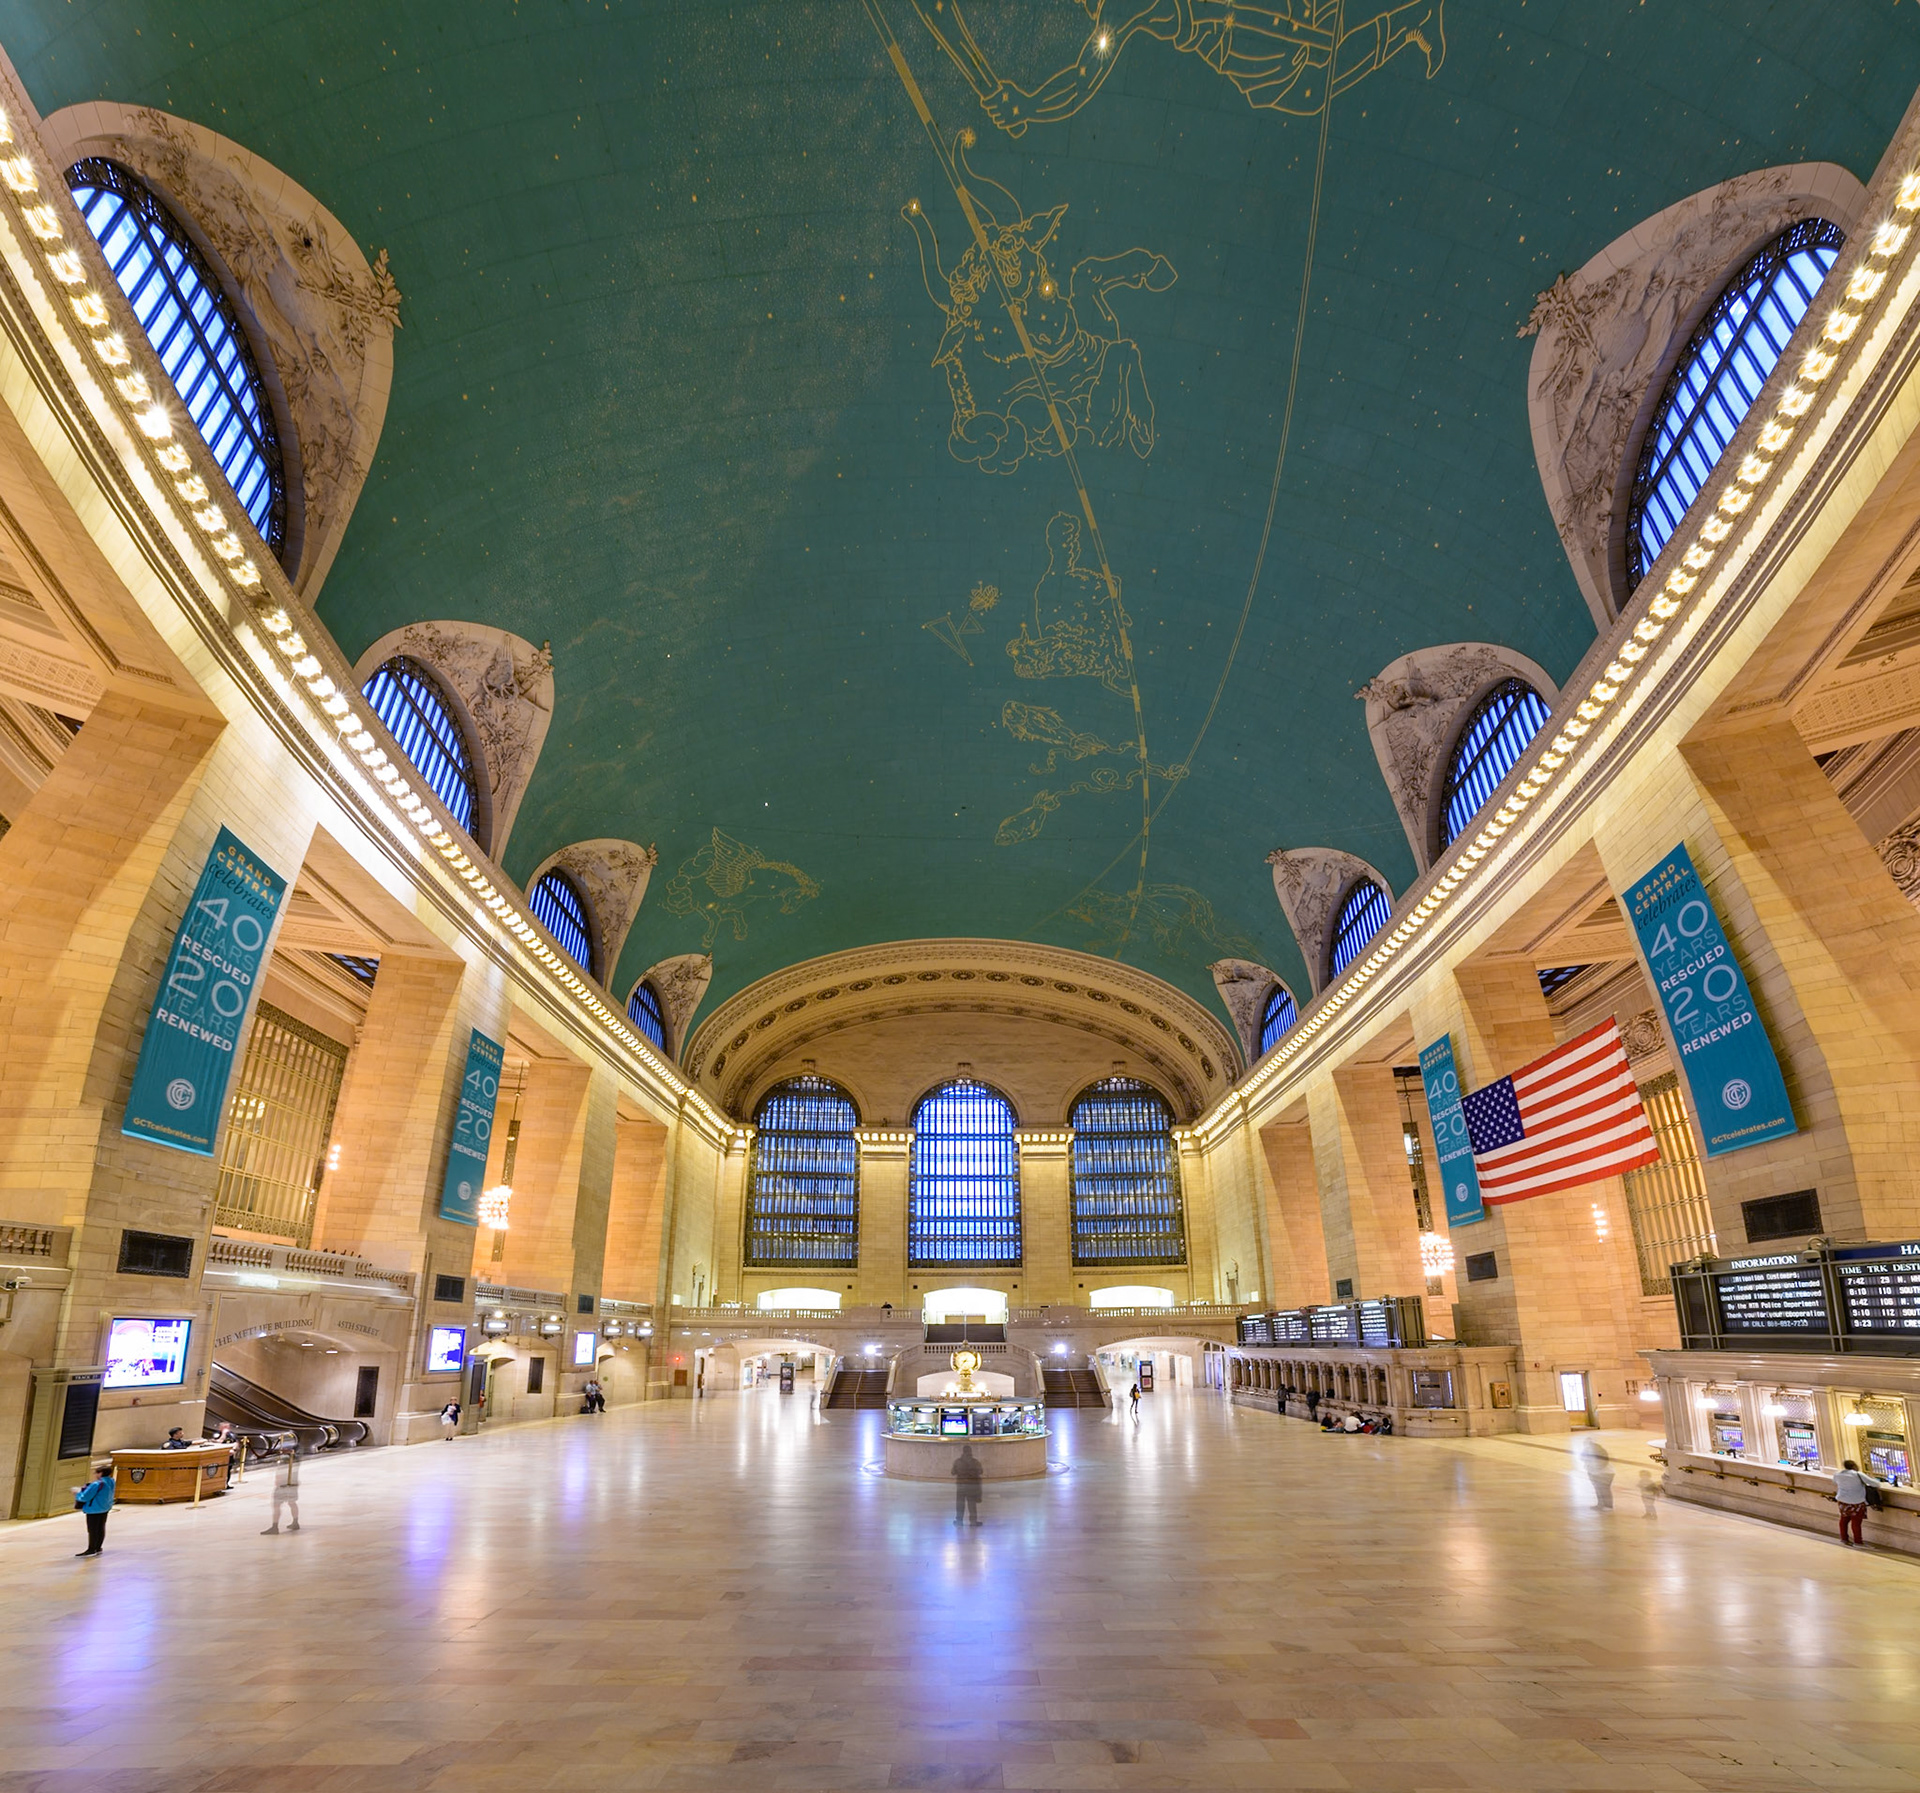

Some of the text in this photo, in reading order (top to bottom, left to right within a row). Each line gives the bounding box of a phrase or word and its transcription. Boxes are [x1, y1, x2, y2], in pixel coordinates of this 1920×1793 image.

[216, 851, 275, 905] CENTRAL
[228, 846, 272, 887] GRAND
[208, 862, 275, 920] celebrates
[1635, 867, 1690, 915] CENTRAL
[1636, 863, 1676, 901] GRAND
[1637, 873, 1697, 931] celebrates
[196, 897, 264, 952] 40
[1650, 900, 1709, 959] 40
[190, 916, 255, 972] YEARS
[1655, 928, 1718, 978] YEARS
[180, 933, 251, 986] RESCUED
[1660, 944, 1725, 992] RESCUED
[168, 954, 243, 1018] 20
[1668, 964, 1737, 1026] 20
[165, 988, 237, 1038] YEARS
[1677, 993, 1748, 1041] YEARS
[156, 1007, 233, 1052] RENEWED
[1682, 1011, 1752, 1056] RENEWED
[471, 1043, 500, 1066] CENTRAL
[476, 1037, 498, 1056] GRAND
[1423, 1048, 1450, 1070] CENTRAL
[1424, 1043, 1445, 1061] GRAND
[466, 1069, 497, 1098] 40
[1428, 1070, 1457, 1100] 40
[461, 1097, 493, 1119] RESCUED
[1432, 1100, 1462, 1122] RESCUED
[132, 1116, 209, 1145] GCTcelebrates.com
[456, 1109, 490, 1141] 20
[1434, 1113, 1466, 1145] 20
[1711, 1116, 1786, 1146] GCTcelebrates.com
[452, 1142, 487, 1162] RENEWED
[1440, 1145, 1471, 1164] RENEWED
[1731, 1255, 1797, 1269] INFORMATION
[1901, 1244, 1920, 1255] HA
[1733, 1274, 1765, 1283] Attention
[1840, 1266, 1862, 1275] TIME
[1867, 1264, 1889, 1273] TRK
[1847, 1277, 1866, 1285] 7:42
[1783, 1300, 1820, 1308] Department
[1795, 1290, 1822, 1298] removed
[1849, 1287, 1867, 1295] 8:10
[1878, 1286, 1892, 1295] 110
[1851, 1298, 1869, 1306] 8:42
[274, 1318, 313, 1330] BUILDING
[1768, 1311, 1783, 1319] your
[1785, 1309, 1826, 1318] cooperation
[1852, 1308, 1871, 1317] 9:10
[1882, 1308, 1896, 1316] 112
[1854, 1319, 1872, 1327] 9:23
[1888, 1319, 1896, 1327] 17
[337, 1320, 380, 1336] 45TH STREET
